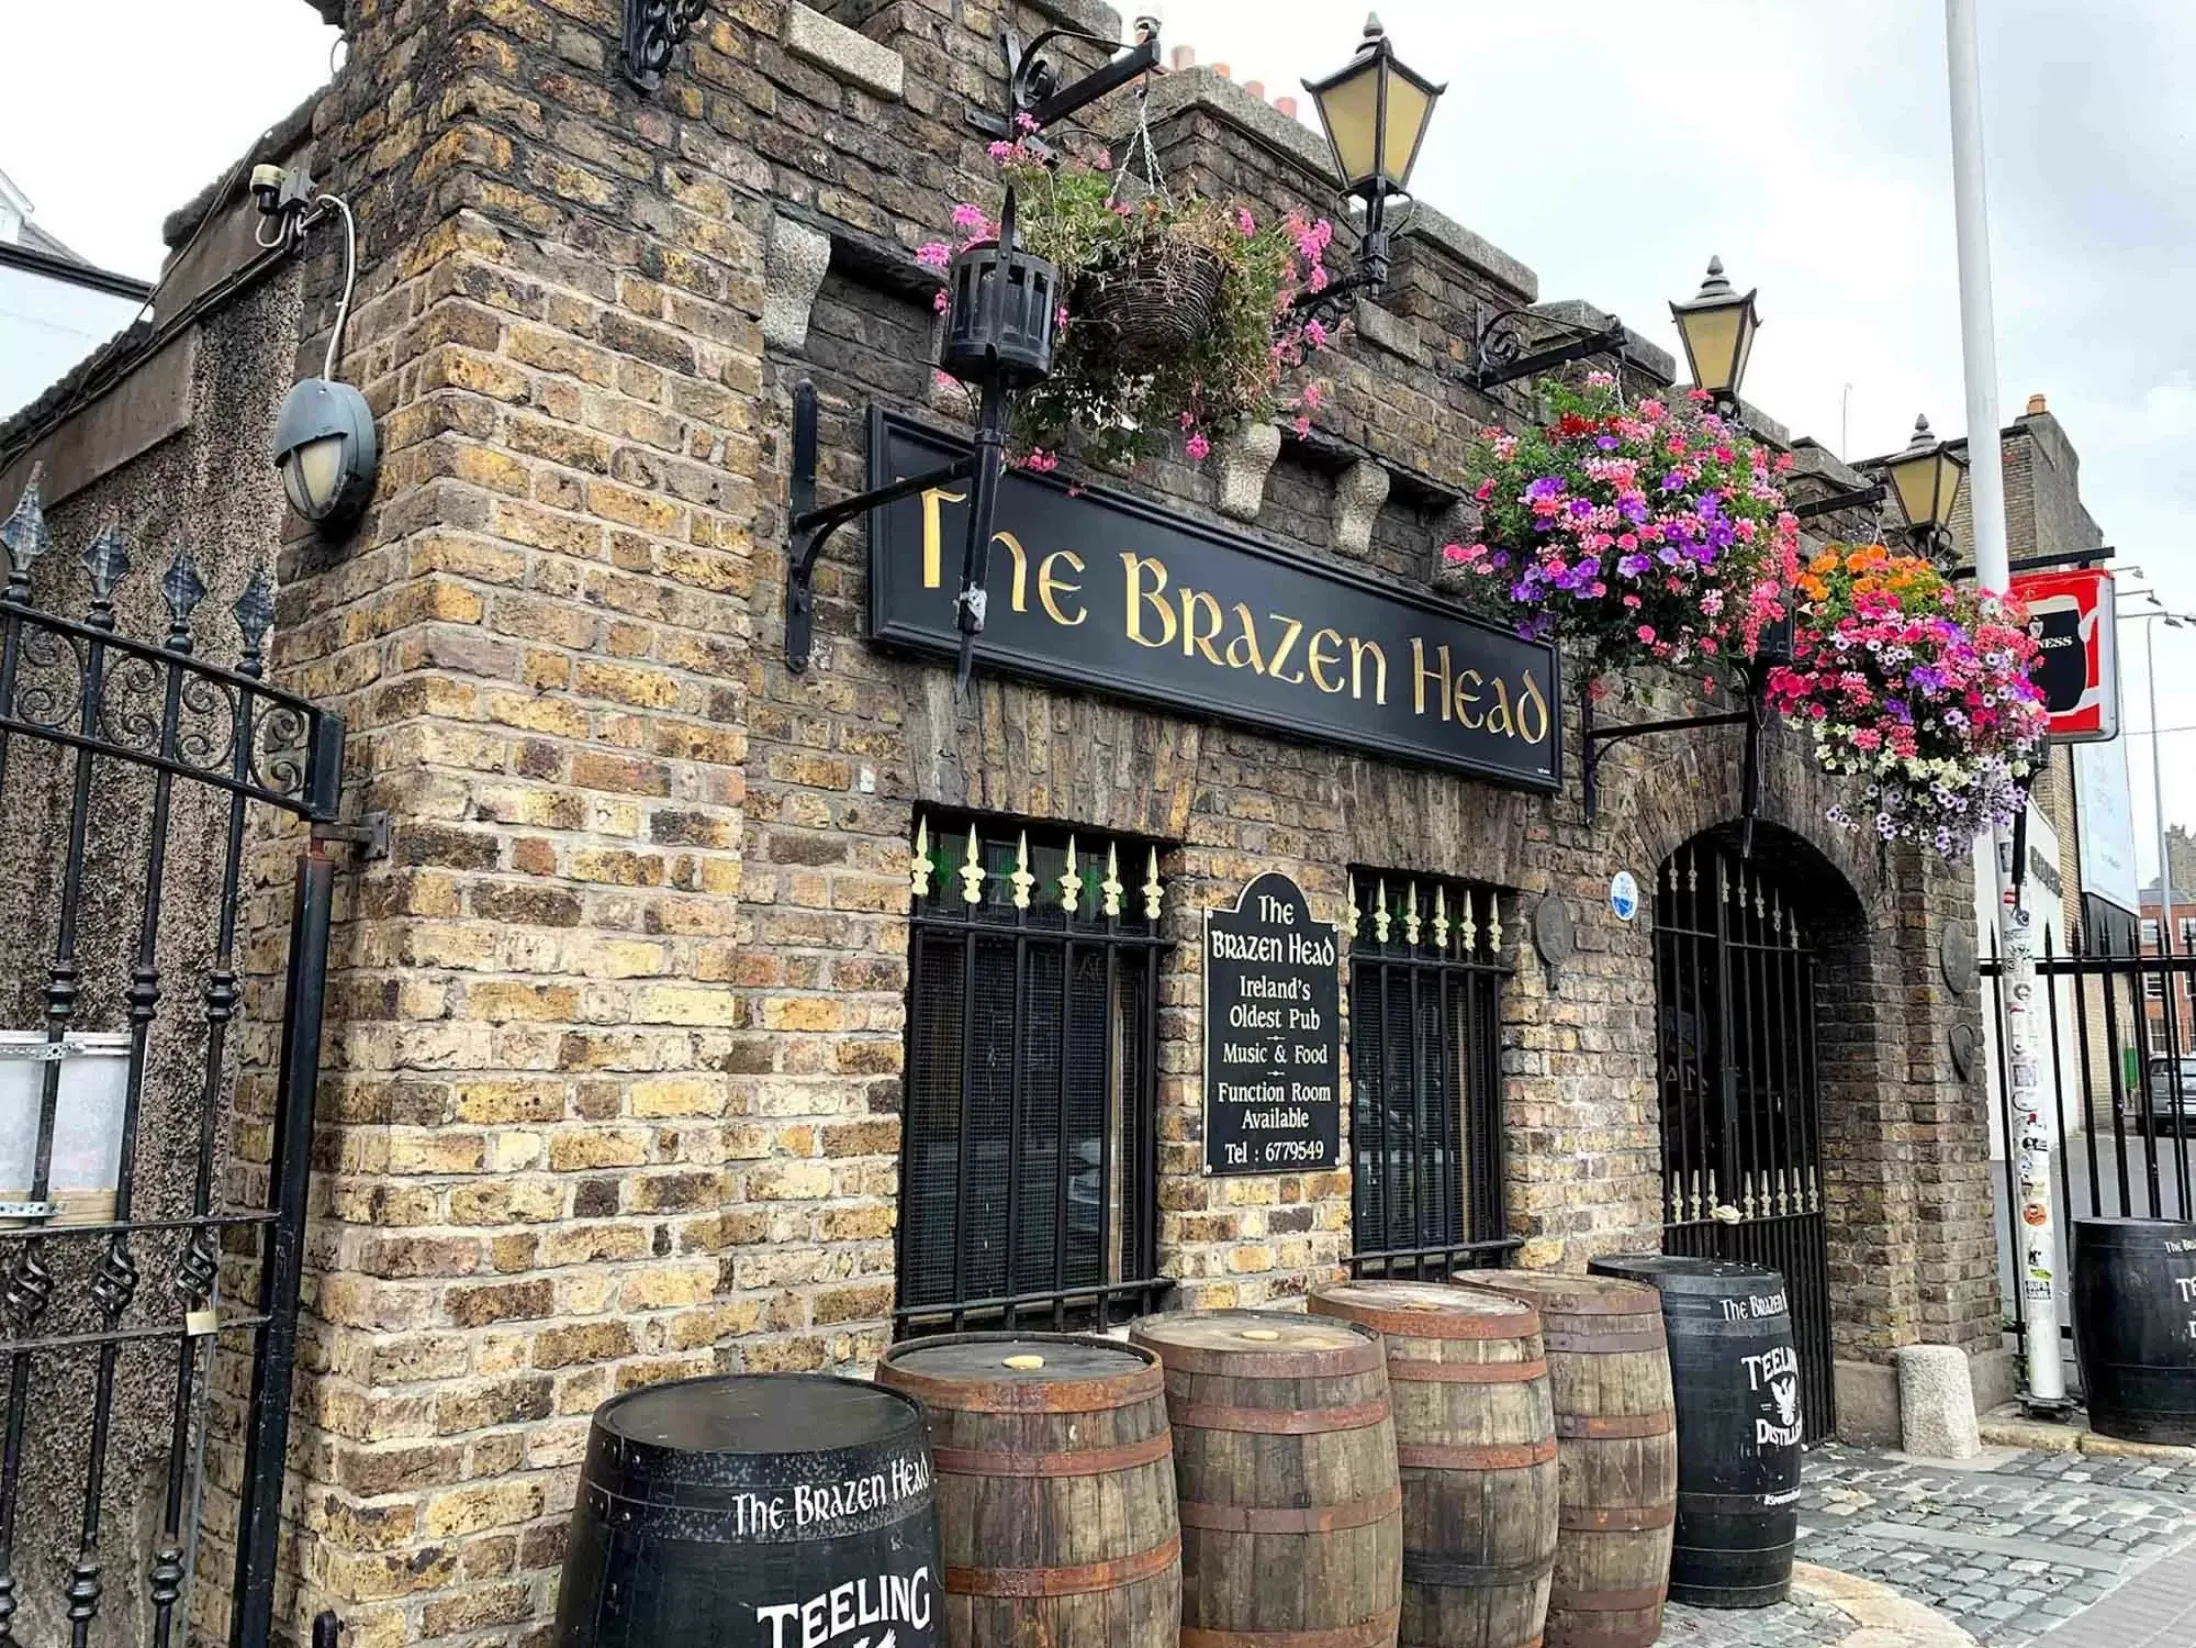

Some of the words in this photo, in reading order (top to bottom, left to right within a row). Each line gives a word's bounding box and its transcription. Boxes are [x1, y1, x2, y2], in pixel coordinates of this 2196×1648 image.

[1120, 551, 1387, 705] Brazen
[1410, 636, 1548, 745] Head
[1257, 894, 1295, 925] The
[1211, 930, 1283, 963] Brazen
[1288, 932, 1335, 967] Head
[1240, 975, 1311, 1001] Ireland's
[1229, 1003, 1282, 1028] Oldest
[1289, 1007, 1321, 1031] Pub
[1222, 1042, 1268, 1064] Music
[1274, 1044, 1288, 1064] &
[1294, 1043, 1328, 1064] Food
[1218, 1081, 1285, 1102] Function
[1291, 1082, 1332, 1102] Room
[1241, 1106, 1309, 1129] Available
[1224, 1141, 1248, 1164] Tel
[1265, 1140, 1325, 1162] 6779549
[1719, 1298, 1748, 1321] The
[732, 1491, 785, 1536] The
[793, 1473, 887, 1526] Brazen
[756, 1566, 931, 1648] TEELING
